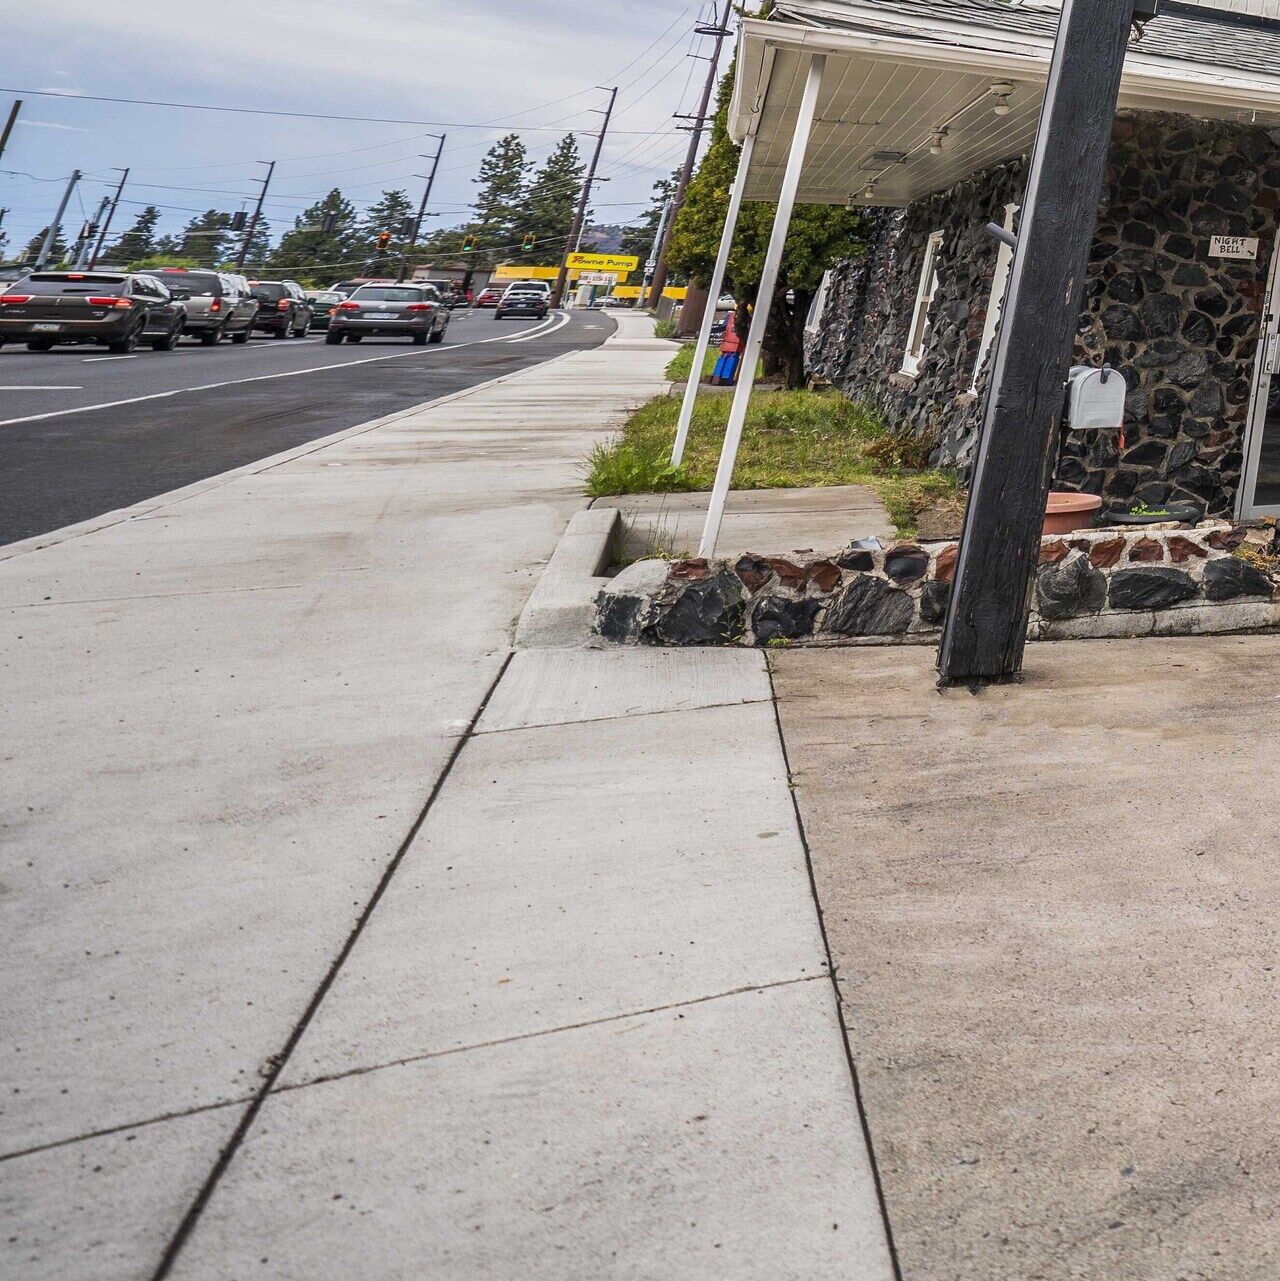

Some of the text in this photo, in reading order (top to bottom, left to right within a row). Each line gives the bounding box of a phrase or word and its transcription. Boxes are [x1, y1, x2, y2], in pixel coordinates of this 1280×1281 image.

[1214, 237, 1247, 246] NIGHT
[1219, 245, 1241, 254] BELL
[571, 255, 634, 268] Towne Pump
